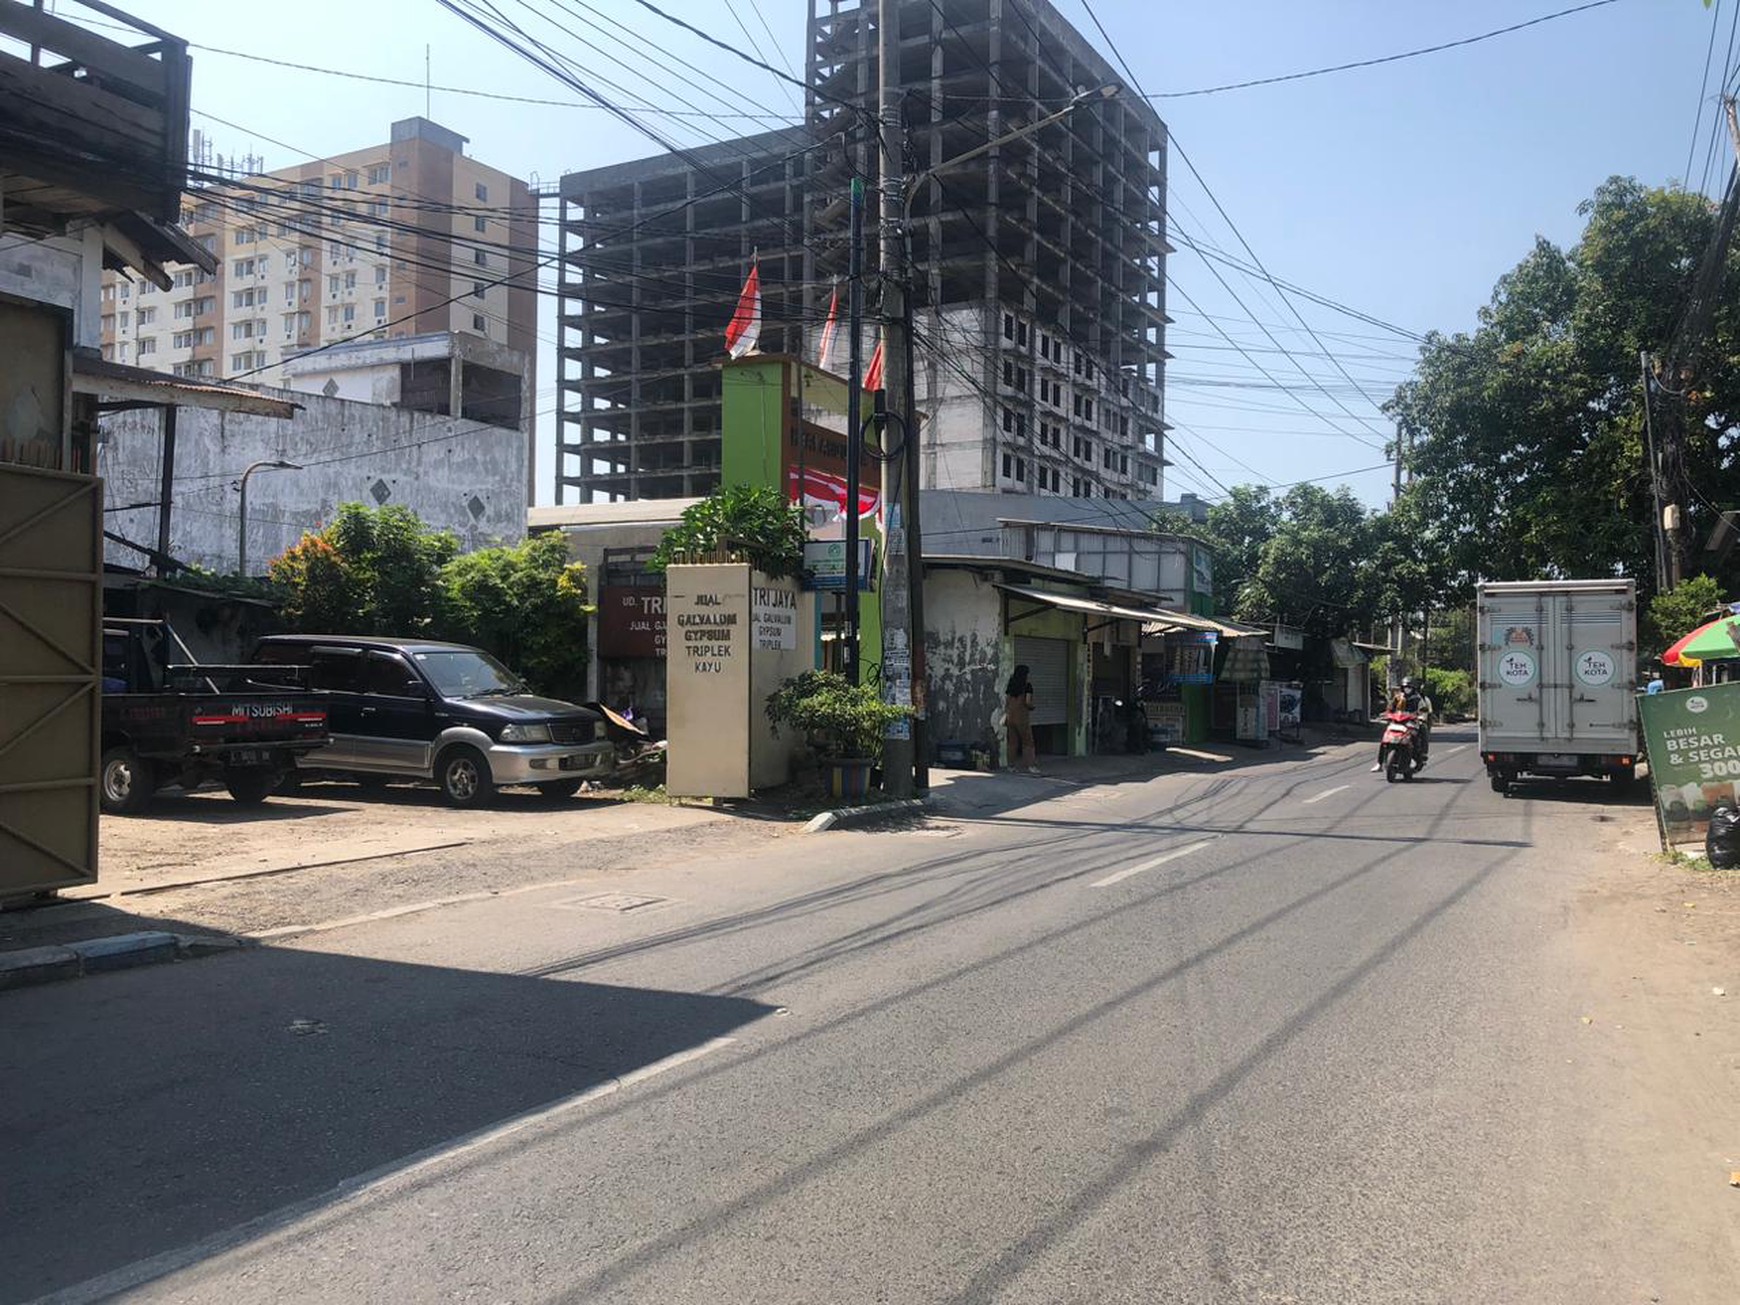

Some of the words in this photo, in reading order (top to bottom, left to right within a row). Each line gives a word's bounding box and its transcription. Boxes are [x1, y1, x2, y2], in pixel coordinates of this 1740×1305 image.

[694, 594, 722, 606] JUAL
[772, 590, 797, 610] JAYA
[684, 629, 731, 642] GYPSUM
[685, 645, 732, 657] TRIPLEK
[695, 661, 722, 673] KAYU
[1587, 661, 1606, 669] TEH
[1506, 669, 1529, 677] KOTA
[1584, 669, 1608, 677] KOTA
[231, 702, 294, 718] MITSUBISHI
[1663, 726, 1697, 739] LEBIH
[1666, 733, 1726, 751] BESAR
[1669, 753, 1684, 765] &
